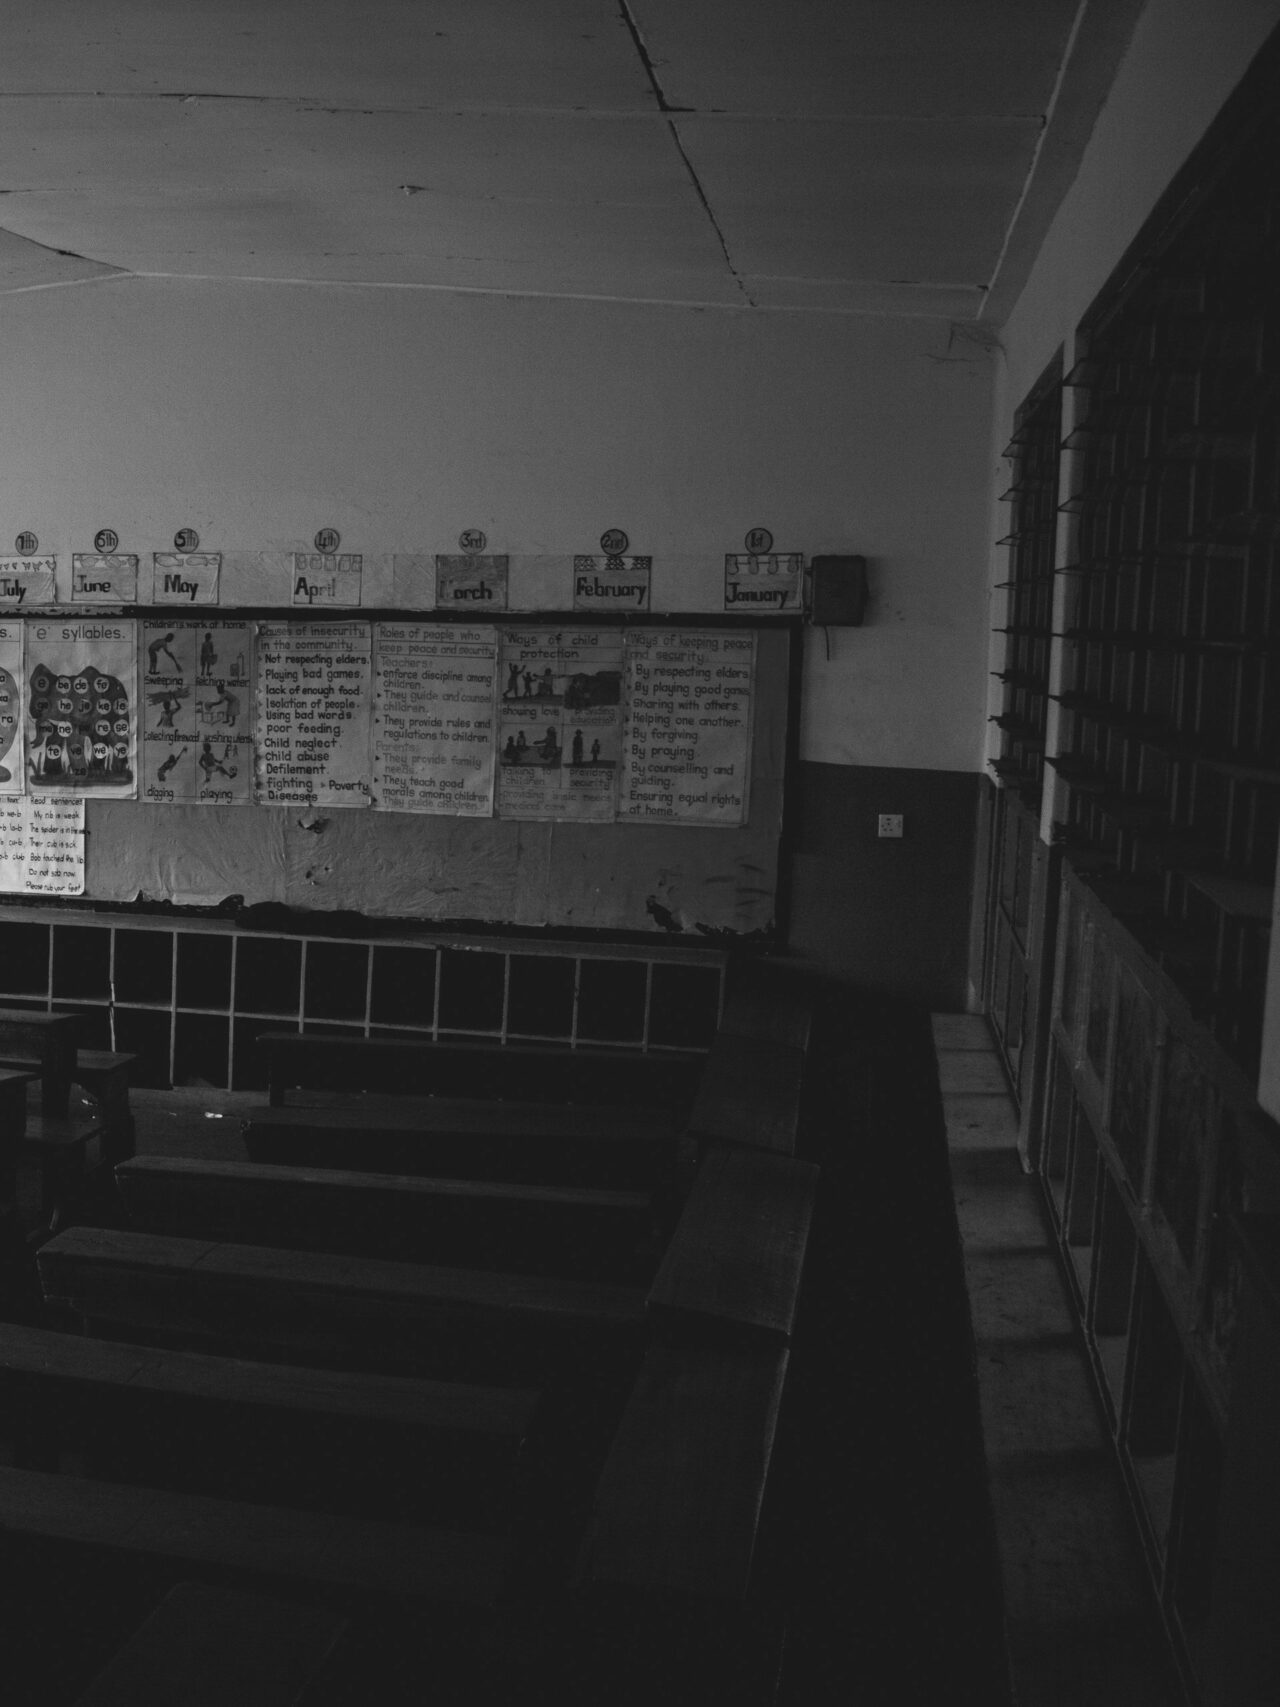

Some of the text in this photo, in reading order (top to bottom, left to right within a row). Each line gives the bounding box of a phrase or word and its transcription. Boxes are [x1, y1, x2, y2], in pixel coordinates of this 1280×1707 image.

[74, 575, 111, 594] June
[164, 574, 199, 601] May
[295, 577, 336, 604] April
[576, 577, 647, 604] February
[727, 583, 789, 609] January
[62, 624, 125, 643] syllables.
[296, 625, 308, 636] of
[311, 625, 366, 639] insecurity
[380, 628, 481, 642] Roles of people who
[507, 633, 598, 646] Ways of child
[261, 640, 270, 650] in
[273, 639, 289, 649] the
[265, 654, 282, 665] Not
[285, 655, 333, 668] respecting
[520, 649, 579, 662] protection
[265, 669, 299, 682] Playing
[303, 668, 322, 679] bad
[383, 669, 492, 687] enforce discipline among
[635, 664, 649, 679] By
[654, 666, 710, 681] respecting
[266, 685, 287, 695] lack
[288, 684, 300, 695] of
[302, 685, 335, 698] enough
[635, 681, 721, 698] By playing good
[266, 699, 308, 710] Isolation
[311, 699, 322, 709] of
[633, 699, 673, 713] Sharing
[678, 700, 699, 710] with
[295, 710, 314, 720] bad
[383, 715, 491, 729] They provide rules and
[633, 711, 671, 728] Helping
[676, 717, 695, 726] one
[383, 729, 437, 740] regulations
[440, 730, 450, 739] to
[632, 727, 698, 744] By forgiving
[264, 738, 290, 748] Child
[297, 751, 330, 761] abuse
[631, 744, 645, 760] By
[631, 762, 734, 779] By counselling and
[266, 777, 313, 792] fighting
[329, 780, 369, 795] Poverty
[383, 775, 464, 791] They teach good
[147, 784, 174, 801] digging
[200, 788, 233, 804] playing
[268, 790, 318, 801] Diseases
[383, 787, 415, 797] morals
[630, 791, 741, 807] Ensuring equal rights
[629, 805, 642, 816] at
